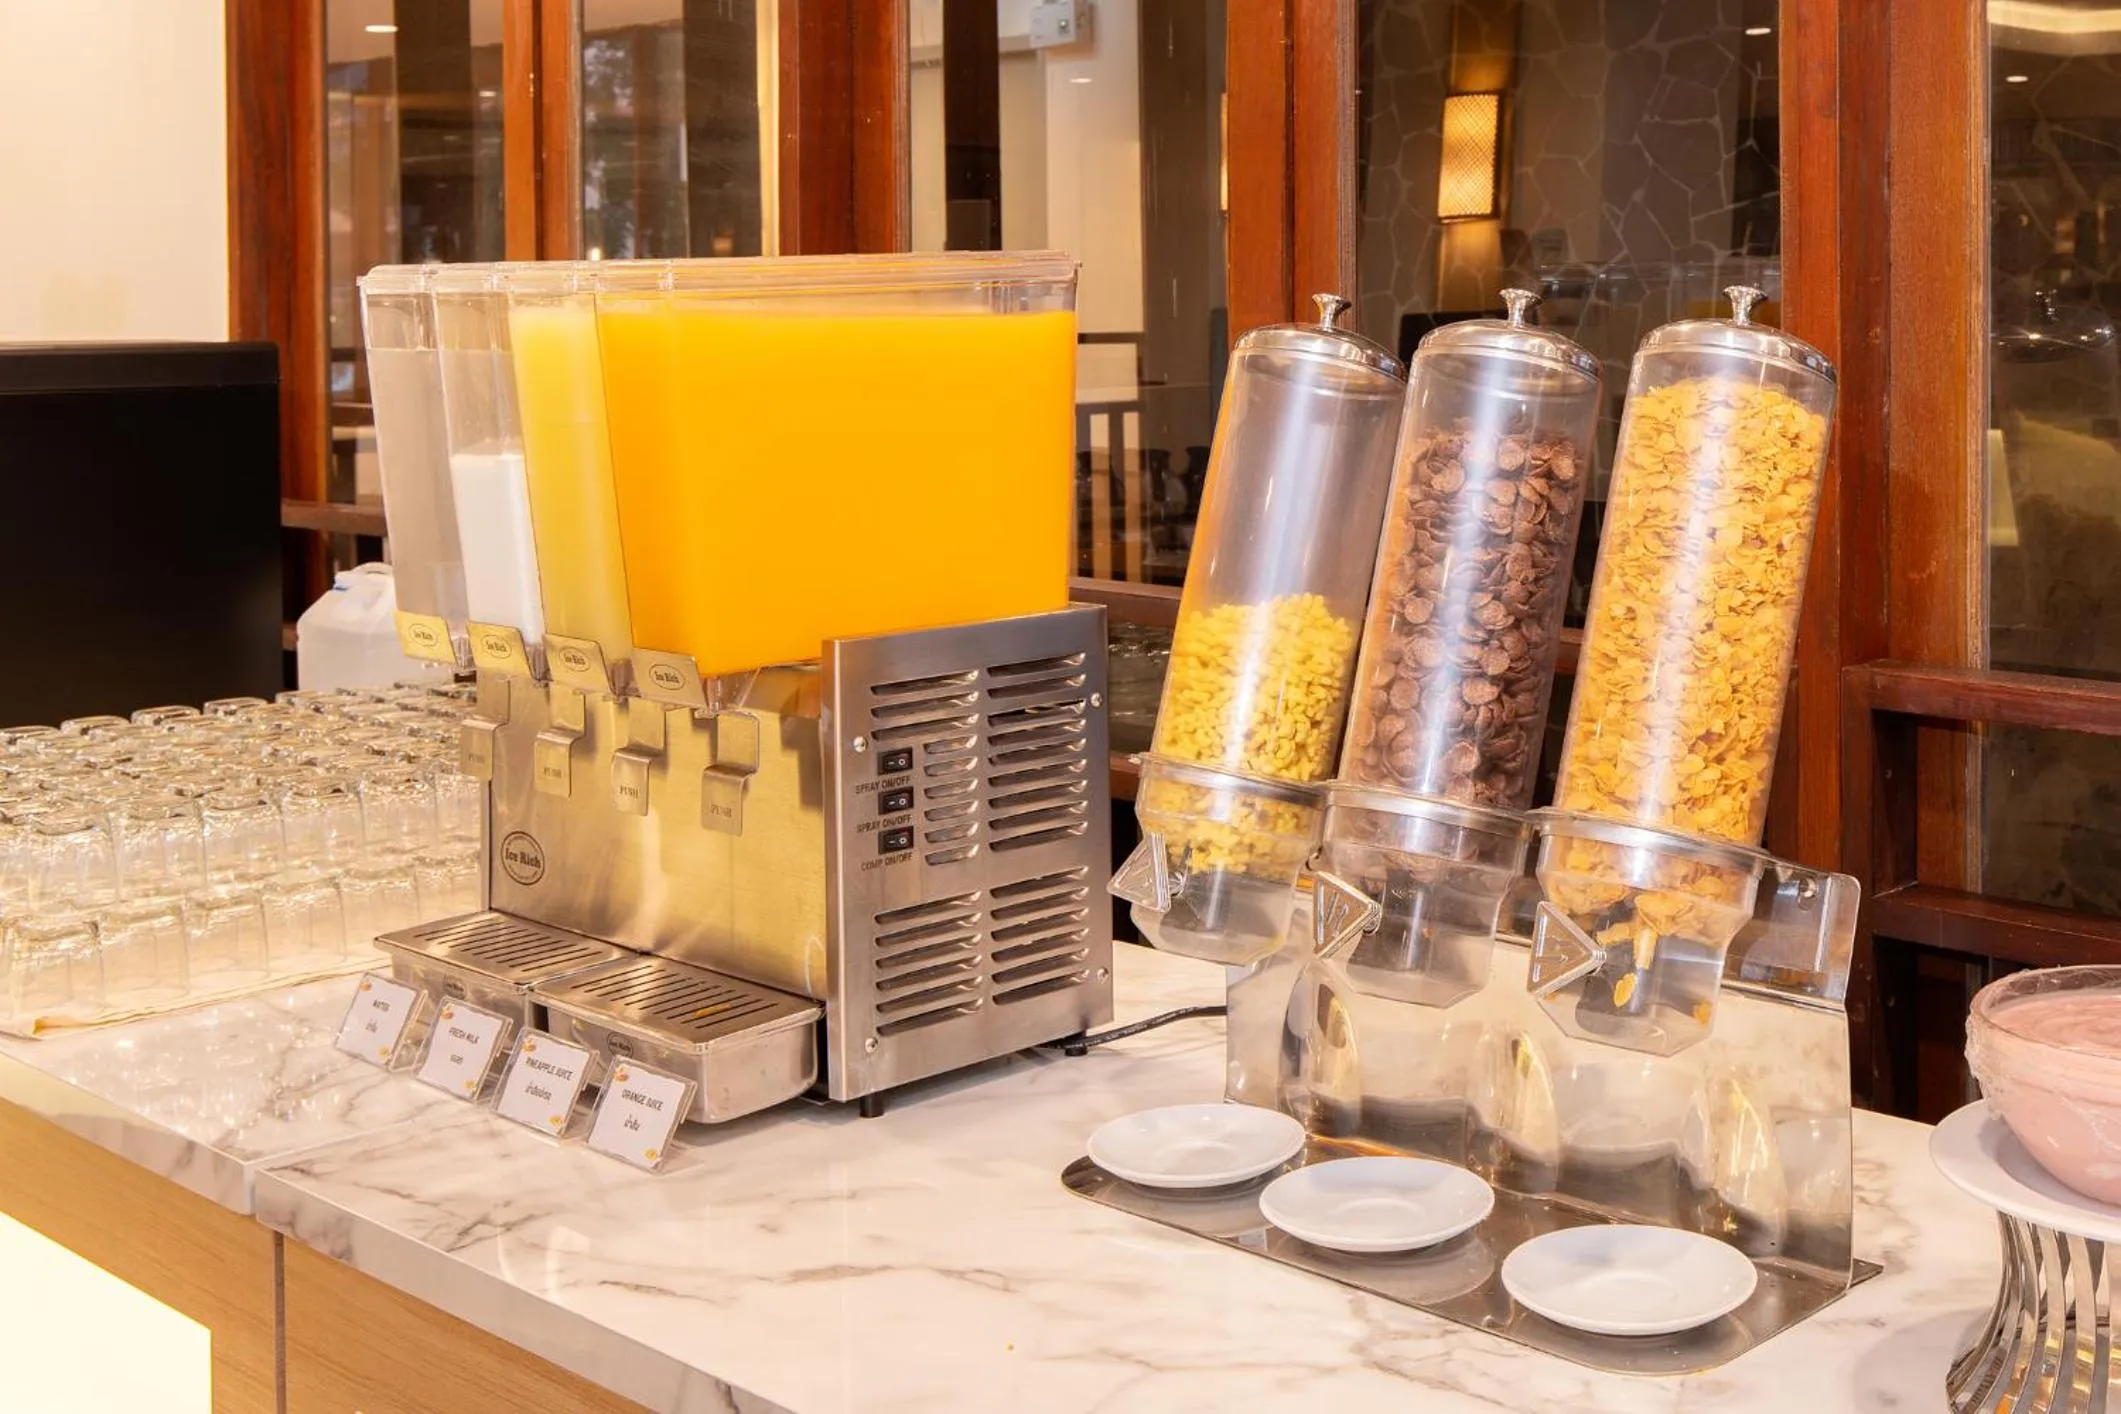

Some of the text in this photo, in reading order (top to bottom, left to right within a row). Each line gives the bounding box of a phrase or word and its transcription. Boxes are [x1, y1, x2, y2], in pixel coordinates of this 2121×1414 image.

[563, 652, 586, 666] Ice Rich
[654, 670, 680, 684] Ice Rich
[619, 785, 639, 799] PUSH
[855, 775, 911, 795] SPRAY ON/OFF
[856, 813, 911, 834] SPRAY ON/OFF
[505, 847, 541, 869] Ice Rich
[861, 851, 912, 872] COMP ON/OFF
[621, 1088, 646, 1105] ORANGE
